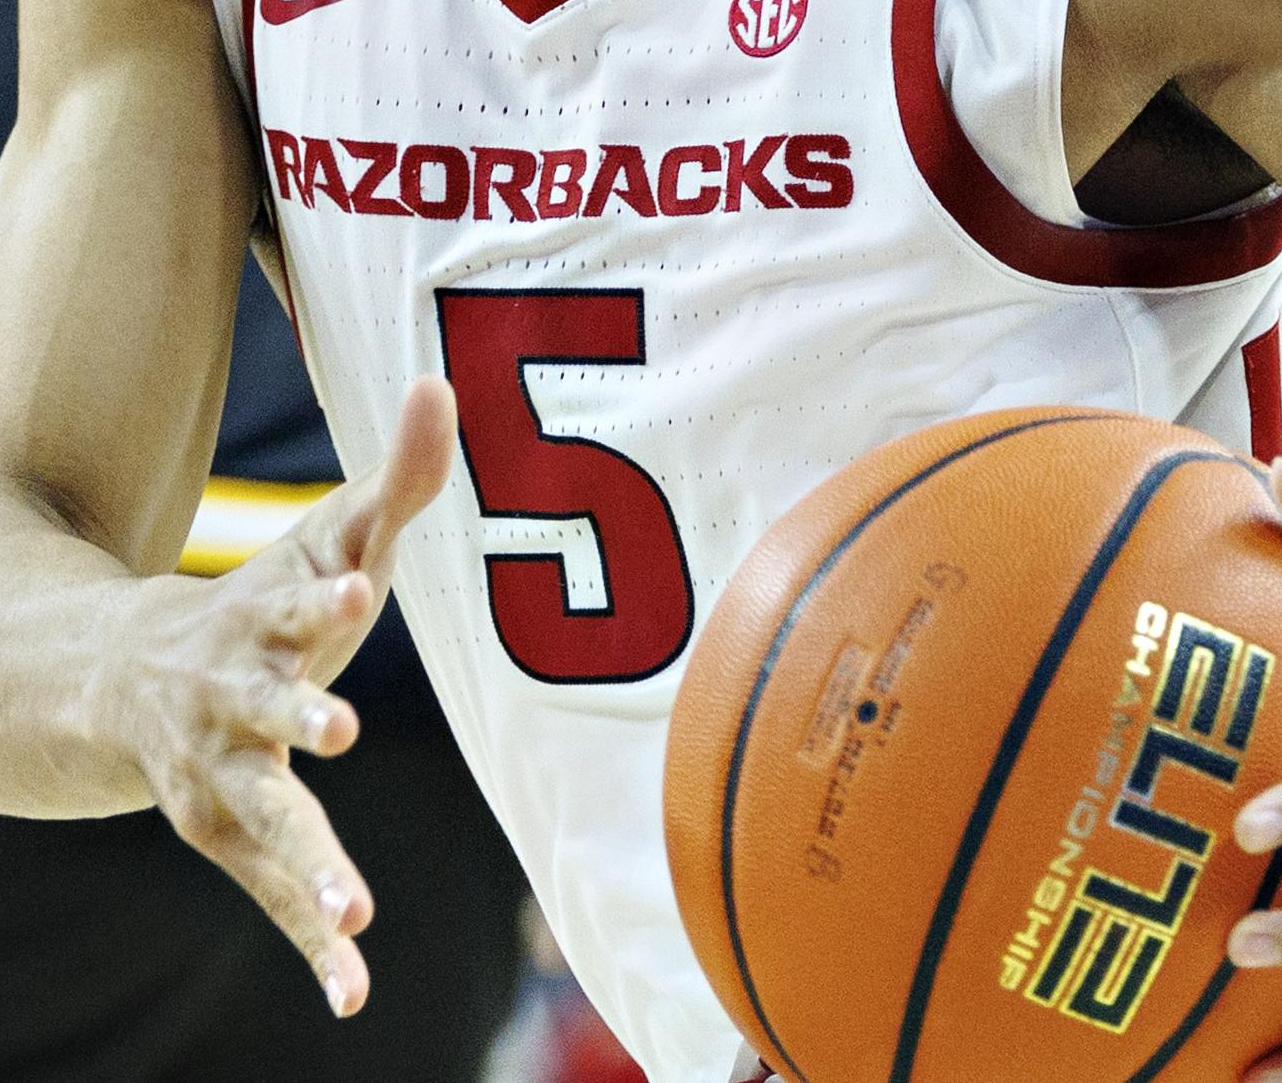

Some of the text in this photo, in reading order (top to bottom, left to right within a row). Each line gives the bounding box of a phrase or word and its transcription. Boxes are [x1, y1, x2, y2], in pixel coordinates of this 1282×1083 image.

[264, 124, 855, 223] RAZORBACKS
[434, 287, 696, 685] 5
[998, 600, 1169, 993] CHAMPIONSHIP
[1021, 610, 1278, 1035] ELITE
